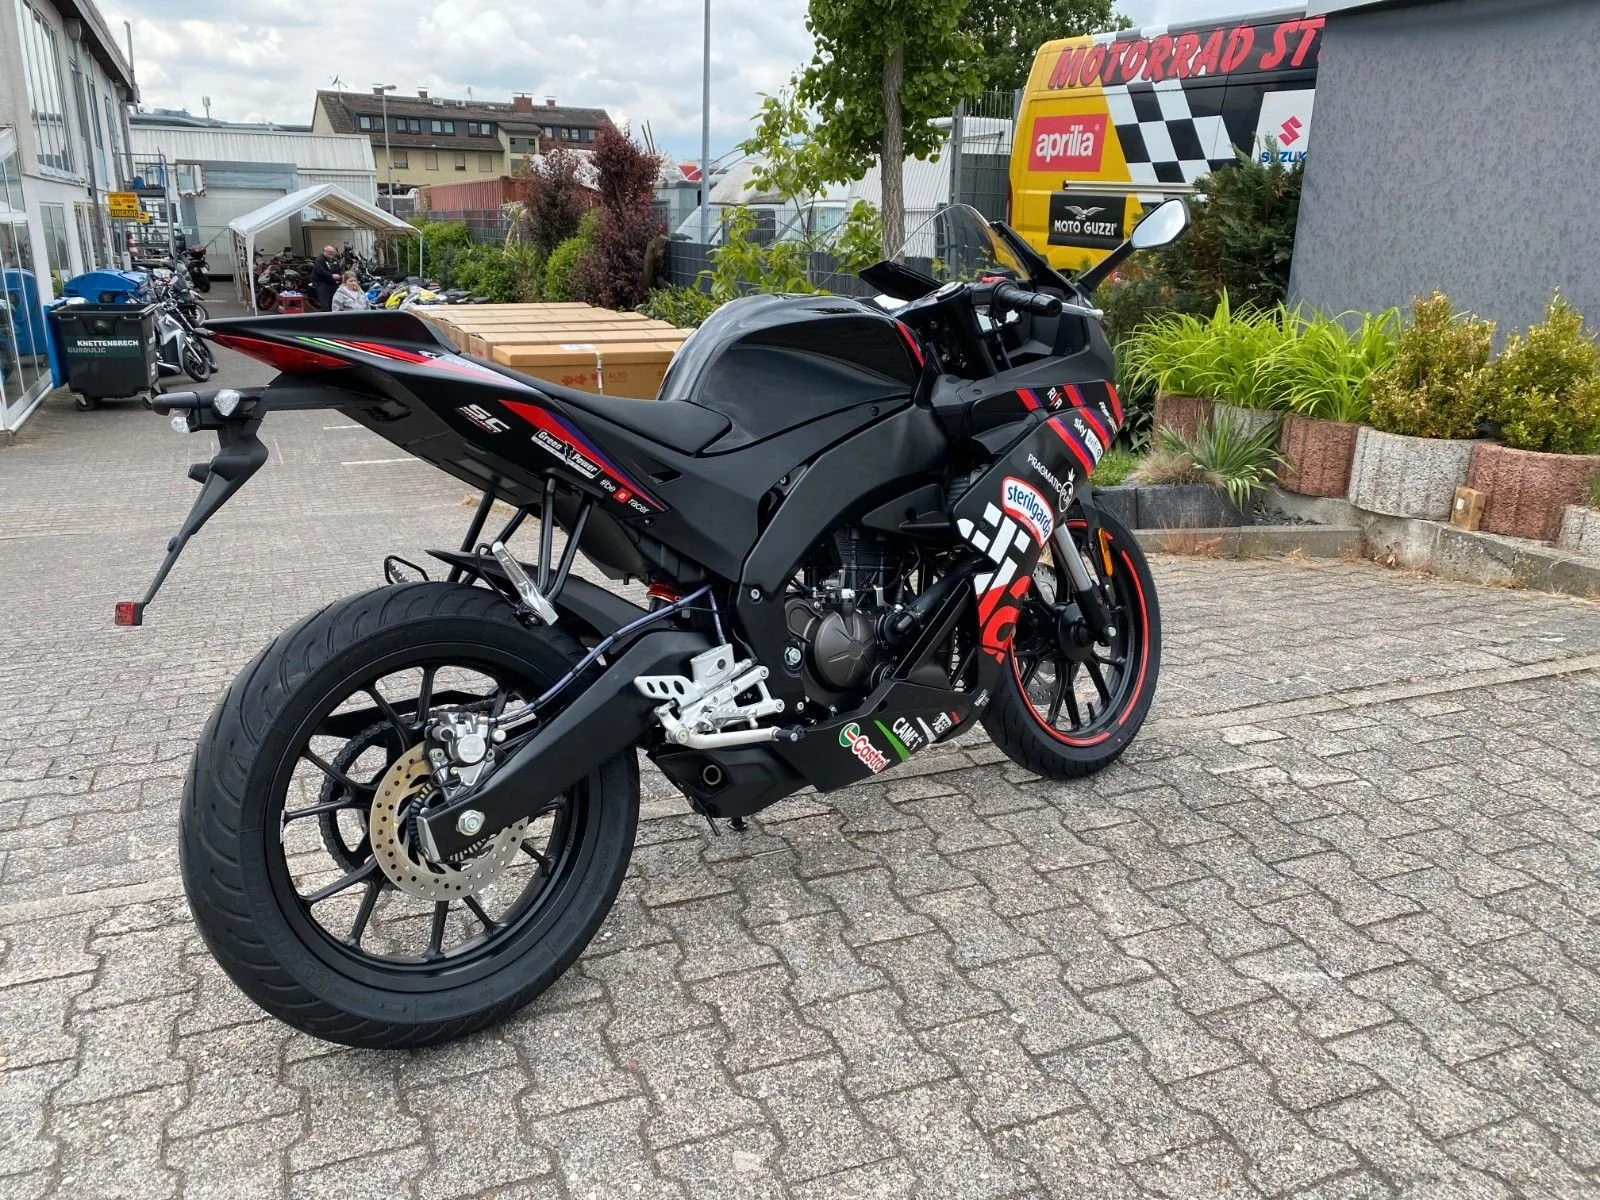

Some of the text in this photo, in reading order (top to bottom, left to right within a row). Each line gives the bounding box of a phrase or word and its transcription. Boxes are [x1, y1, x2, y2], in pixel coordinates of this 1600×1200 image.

[1048, 17, 1326, 90] MOTORRAD ST
[1035, 124, 1096, 163] aprilia
[1261, 151, 1307, 163] SZUK
[1054, 219, 1115, 237] MOTO GUZZI
[76, 339, 139, 347] KNETTENBRECH
[608, 371, 627, 379] ALTO
[1073, 417, 1088, 438] sky
[537, 430, 563, 450] Green
[571, 453, 598, 473] Power
[1027, 453, 1062, 493] PRAGMATIC
[627, 498, 650, 514] racer
[1007, 484, 1052, 538] sterilgarda
[852, 735, 891, 775] Castrol
